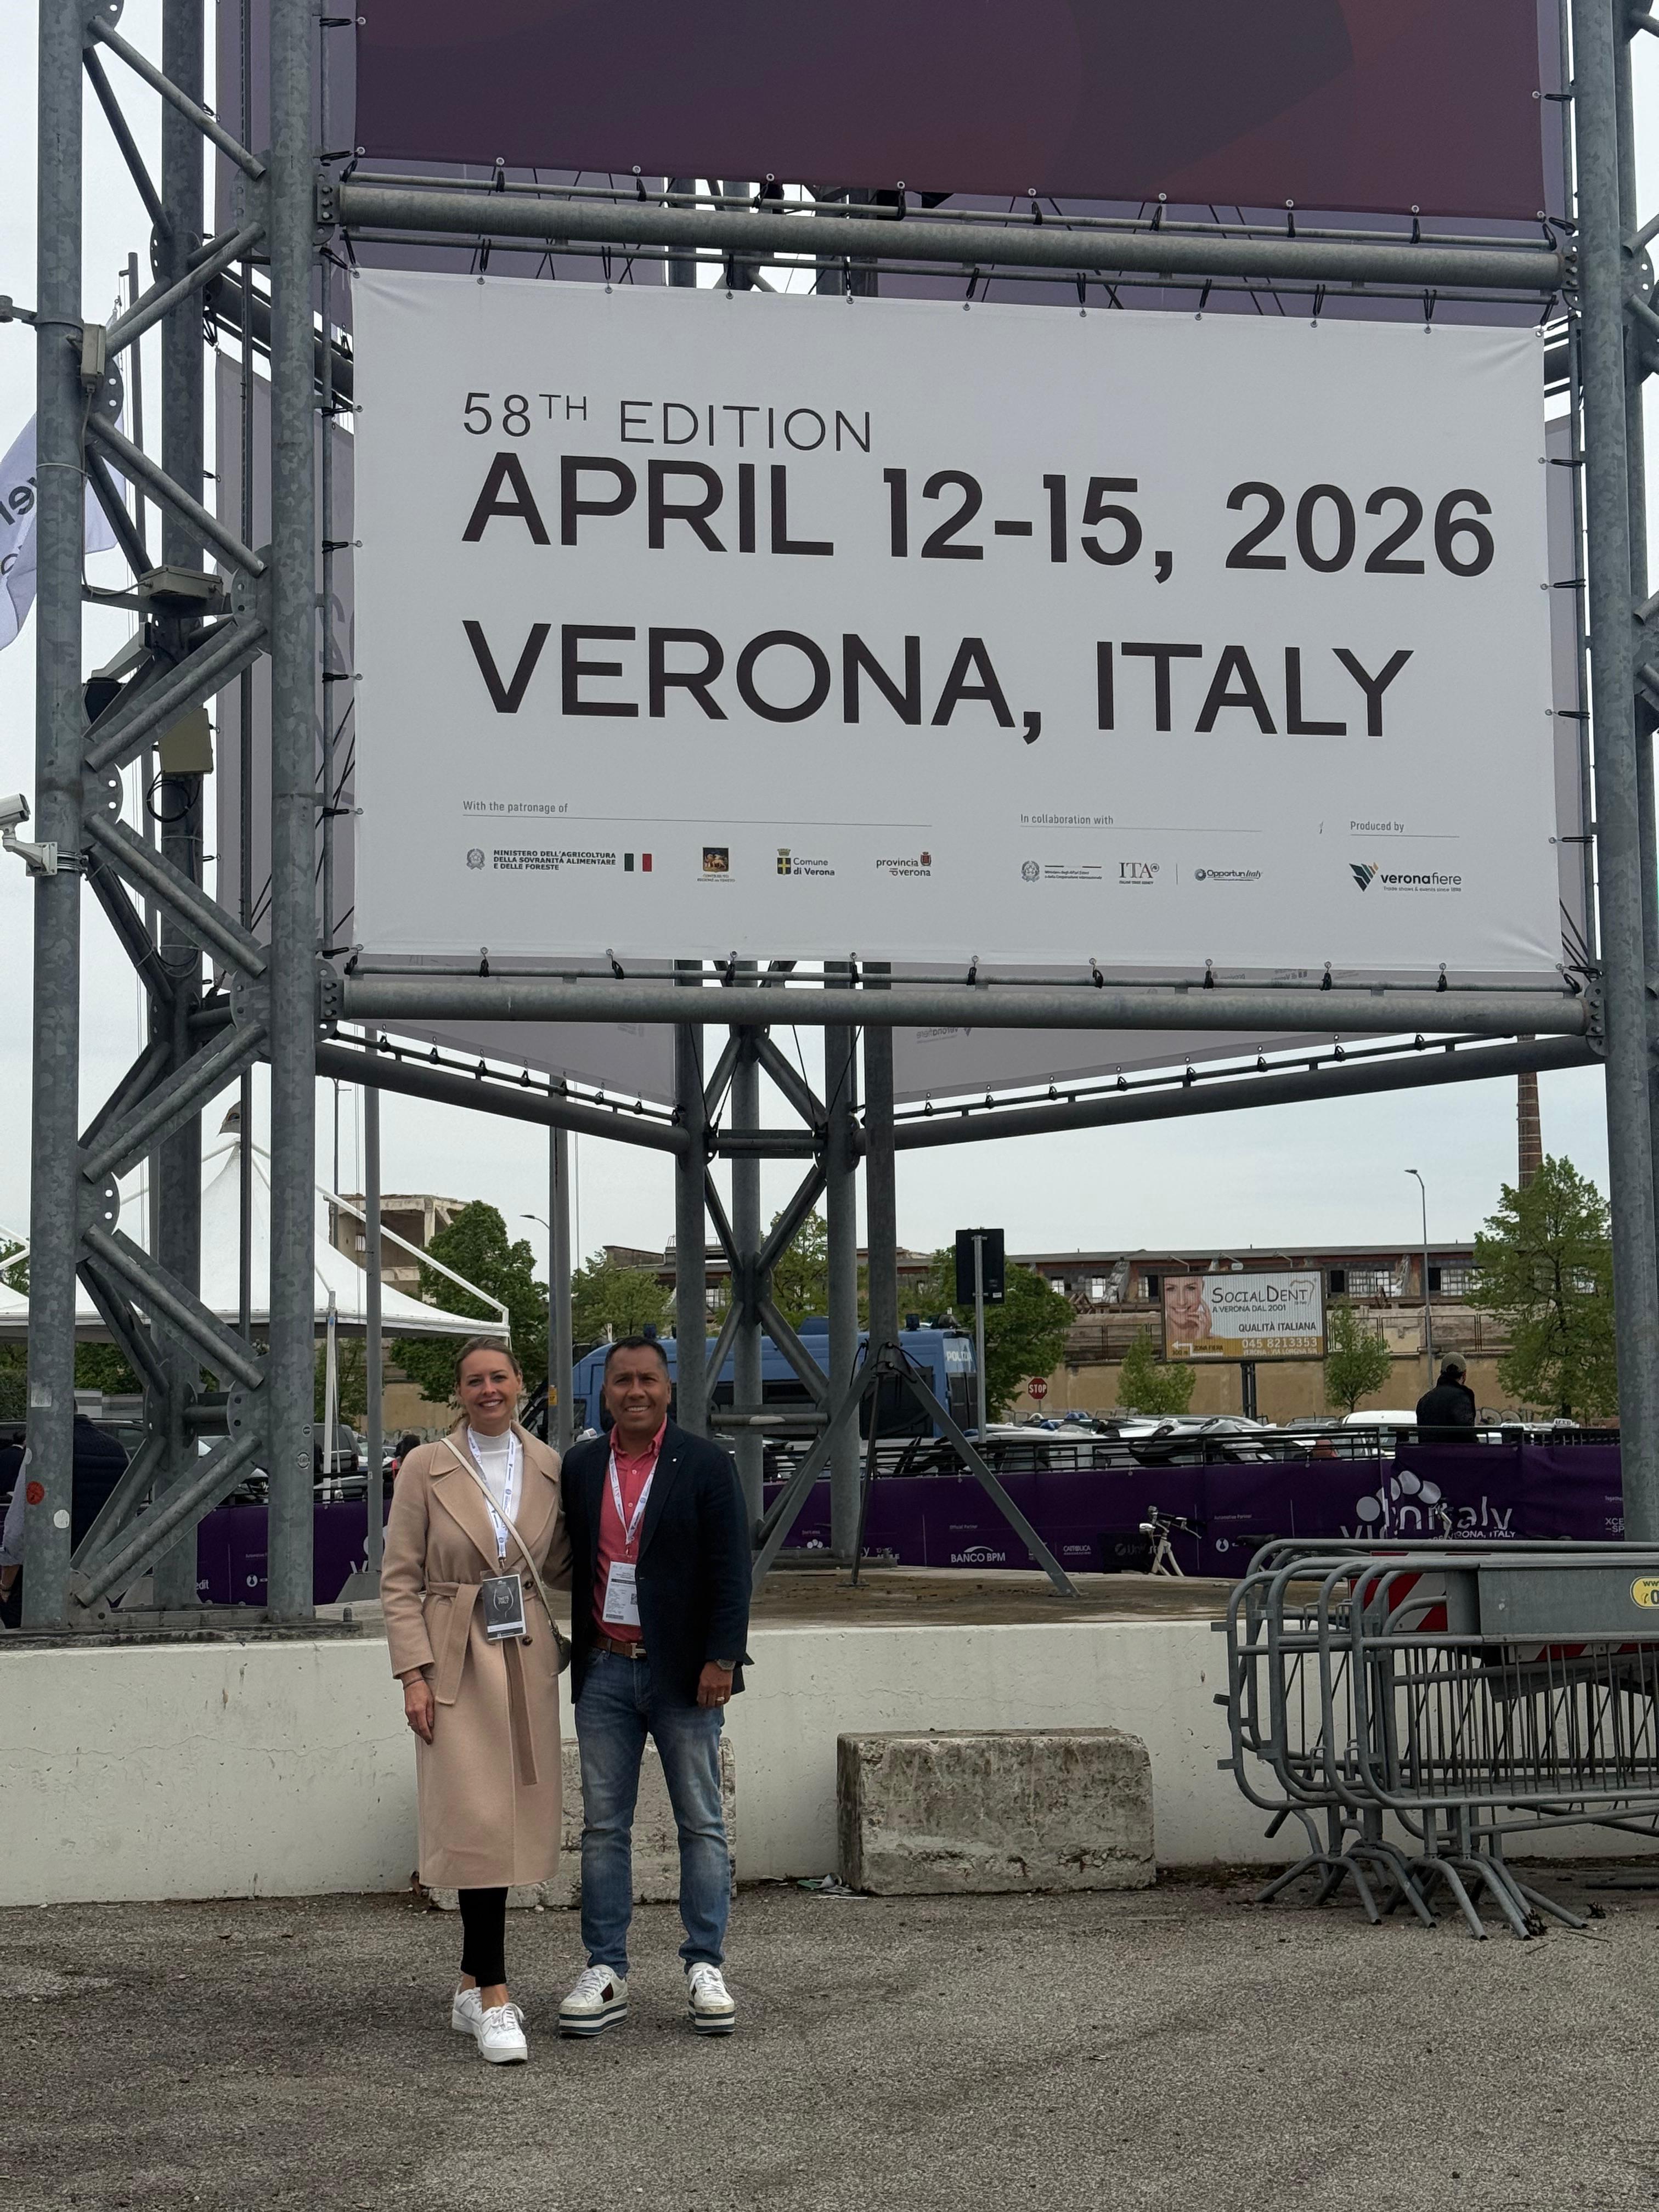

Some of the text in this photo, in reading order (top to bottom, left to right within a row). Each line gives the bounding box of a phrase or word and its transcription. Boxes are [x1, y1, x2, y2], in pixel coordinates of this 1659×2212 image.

[464, 392, 870, 453] 58TH EDITION
[461, 452, 1495, 584] APRIL 12-15, 2026
[462, 620, 1041, 745] VERONA,
[1097, 641, 1415, 737] ITALY
[462, 800, 568, 815] With the patronage of
[1020, 814, 1114, 825] In collaboration with
[1350, 821, 1404, 833] Produced by
[793, 857, 828, 866] Comune
[876, 858, 919, 869] provincia
[793, 867, 835, 876] di Verona
[1119, 862, 1153, 878] ITA
[1380, 872, 1462, 885] veronafiere
[1219, 1305, 1251, 1313] VERONA
[1251, 1305, 1267, 1313] DAL
[1239, 1321, 1317, 1333] QUALITÀ ITALIANA
[1242, 1336, 1317, 1348] 045 8213353
[1029, 1384, 1047, 1394] STOP
[1489, 1530, 1516, 1538] ITALY
[951, 1552, 1006, 1563] BANCO BPM
